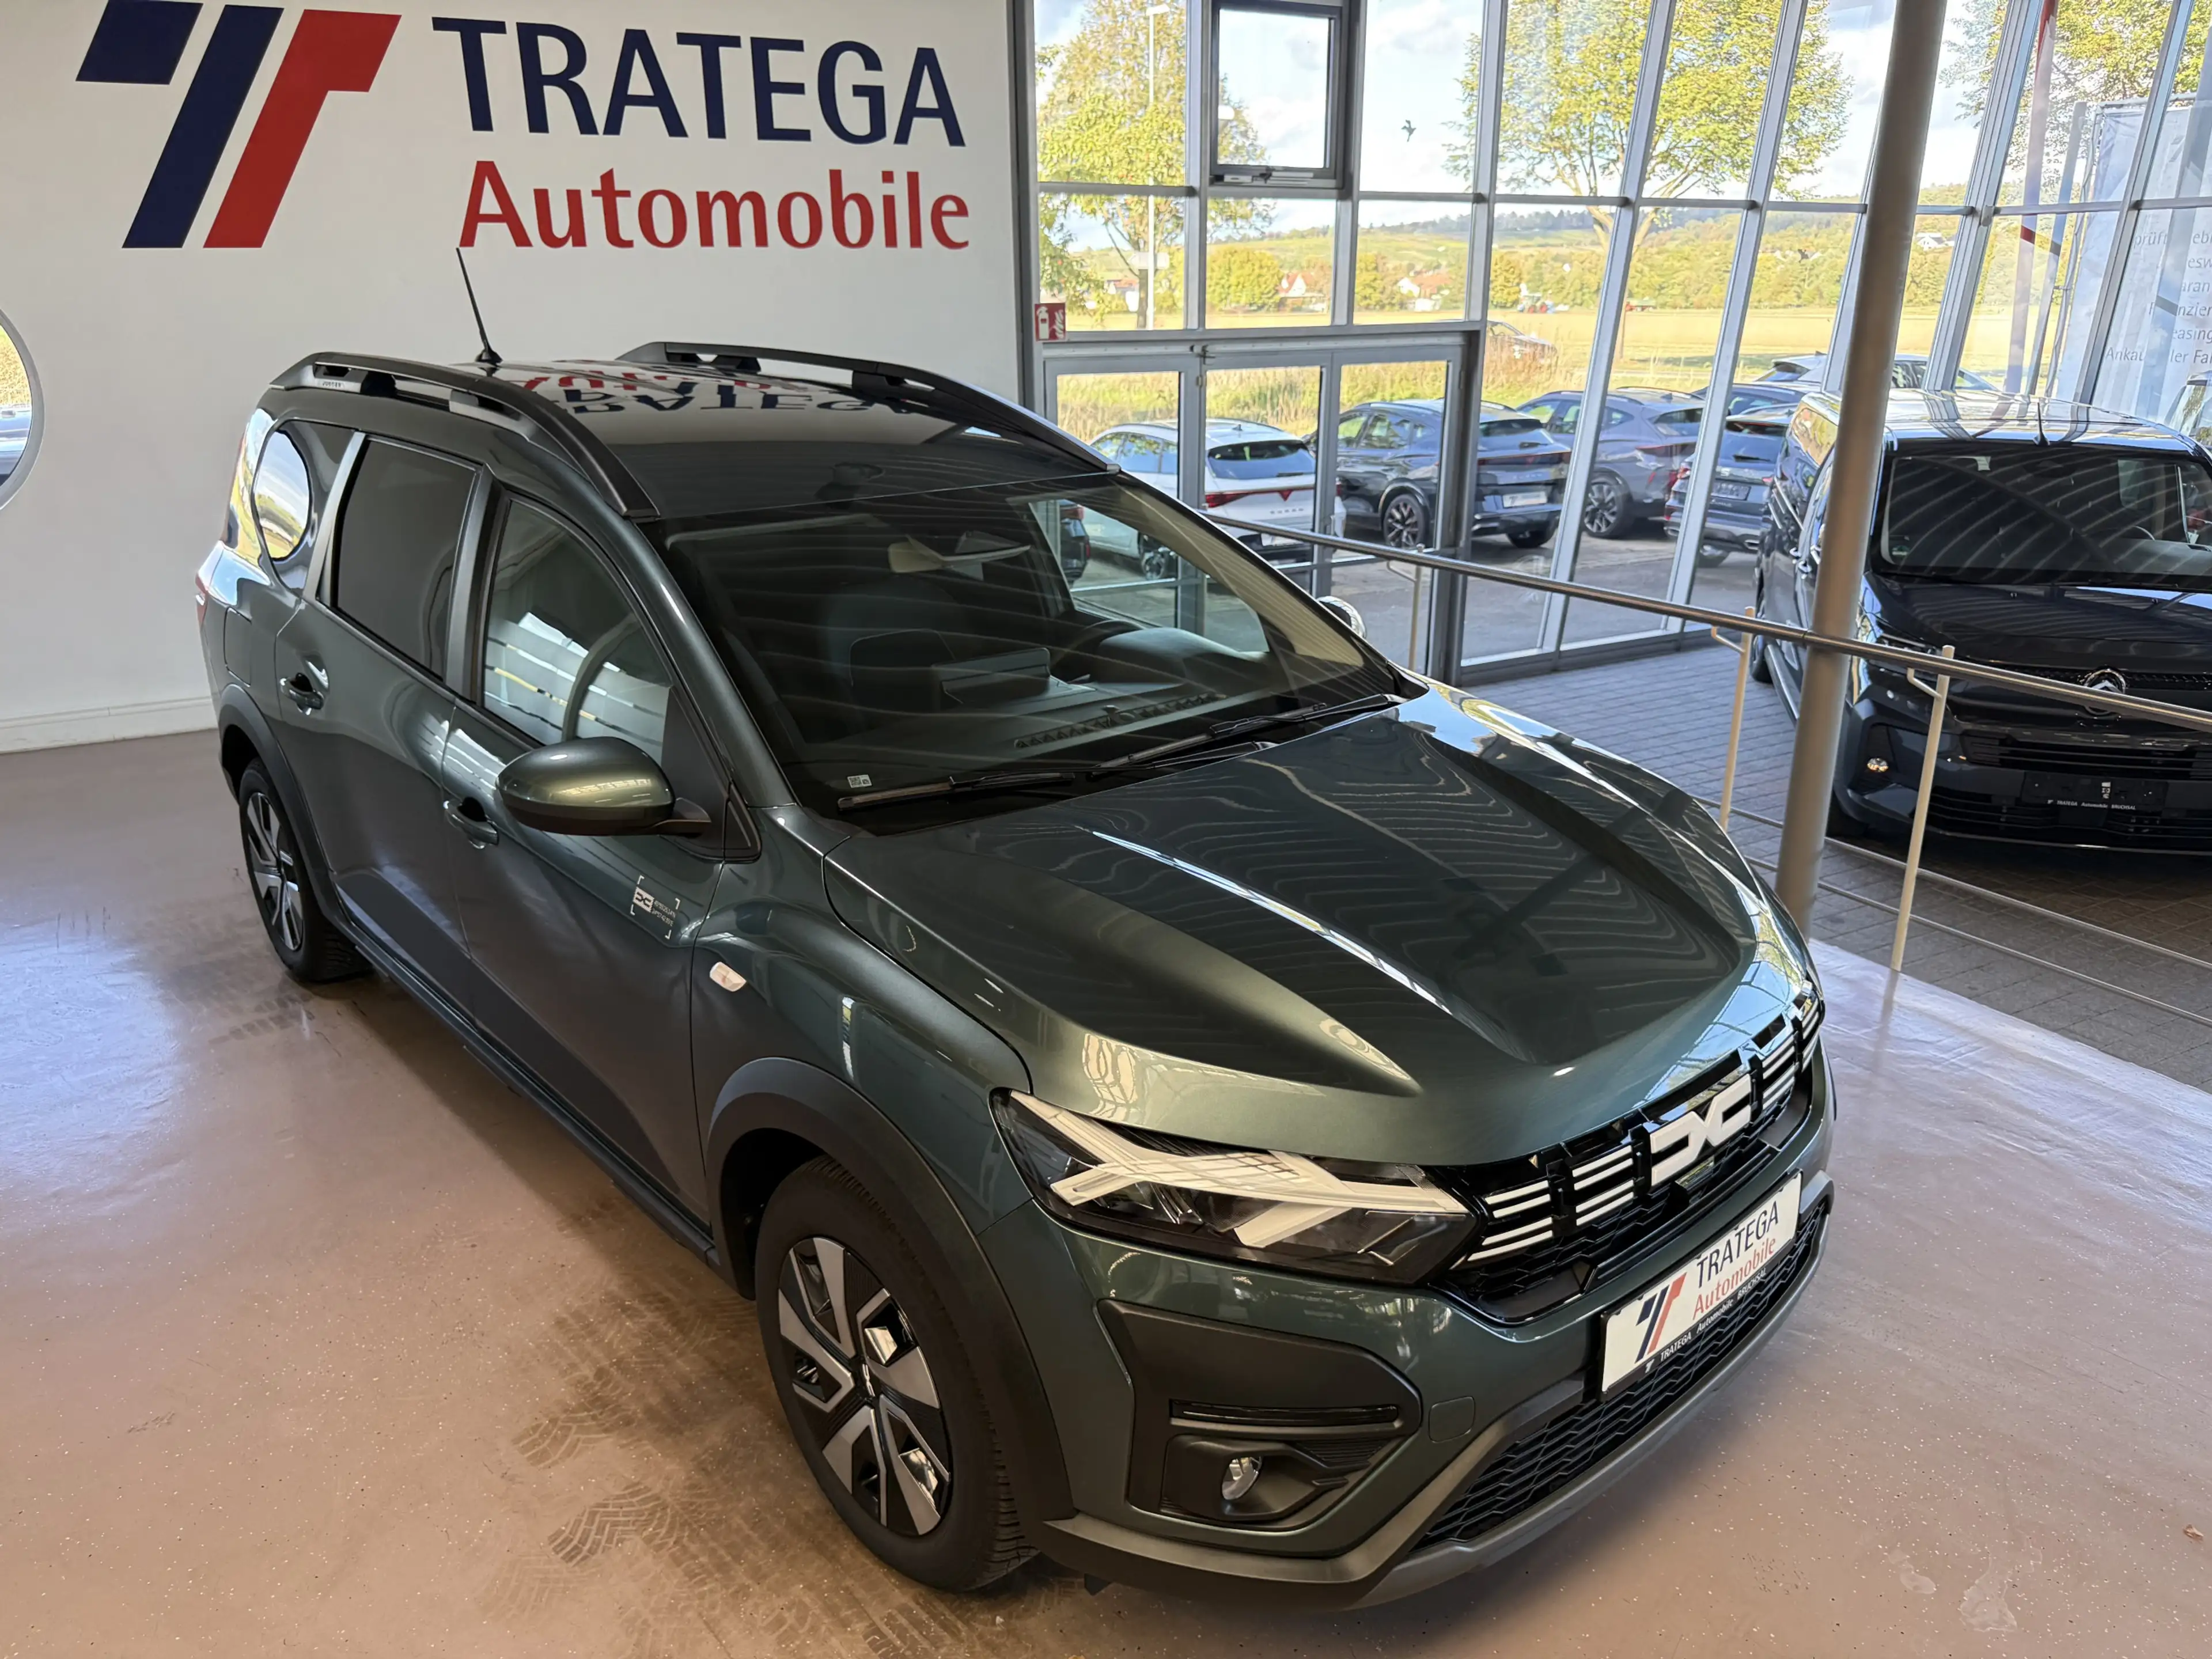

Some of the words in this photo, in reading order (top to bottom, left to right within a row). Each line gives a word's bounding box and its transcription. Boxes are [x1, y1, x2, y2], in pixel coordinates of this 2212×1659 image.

[433, 17, 966, 147] TRATEGA
[459, 160, 969, 250] Automobile
[1692, 1236, 1777, 1321] Automobile
[1696, 1200, 1779, 1289] TRATEGA
[1660, 1331, 1692, 1362] TRATEGA
[1696, 1298, 1734, 1334] Automobile
[1737, 1268, 1767, 1299] BRUCHSAL
